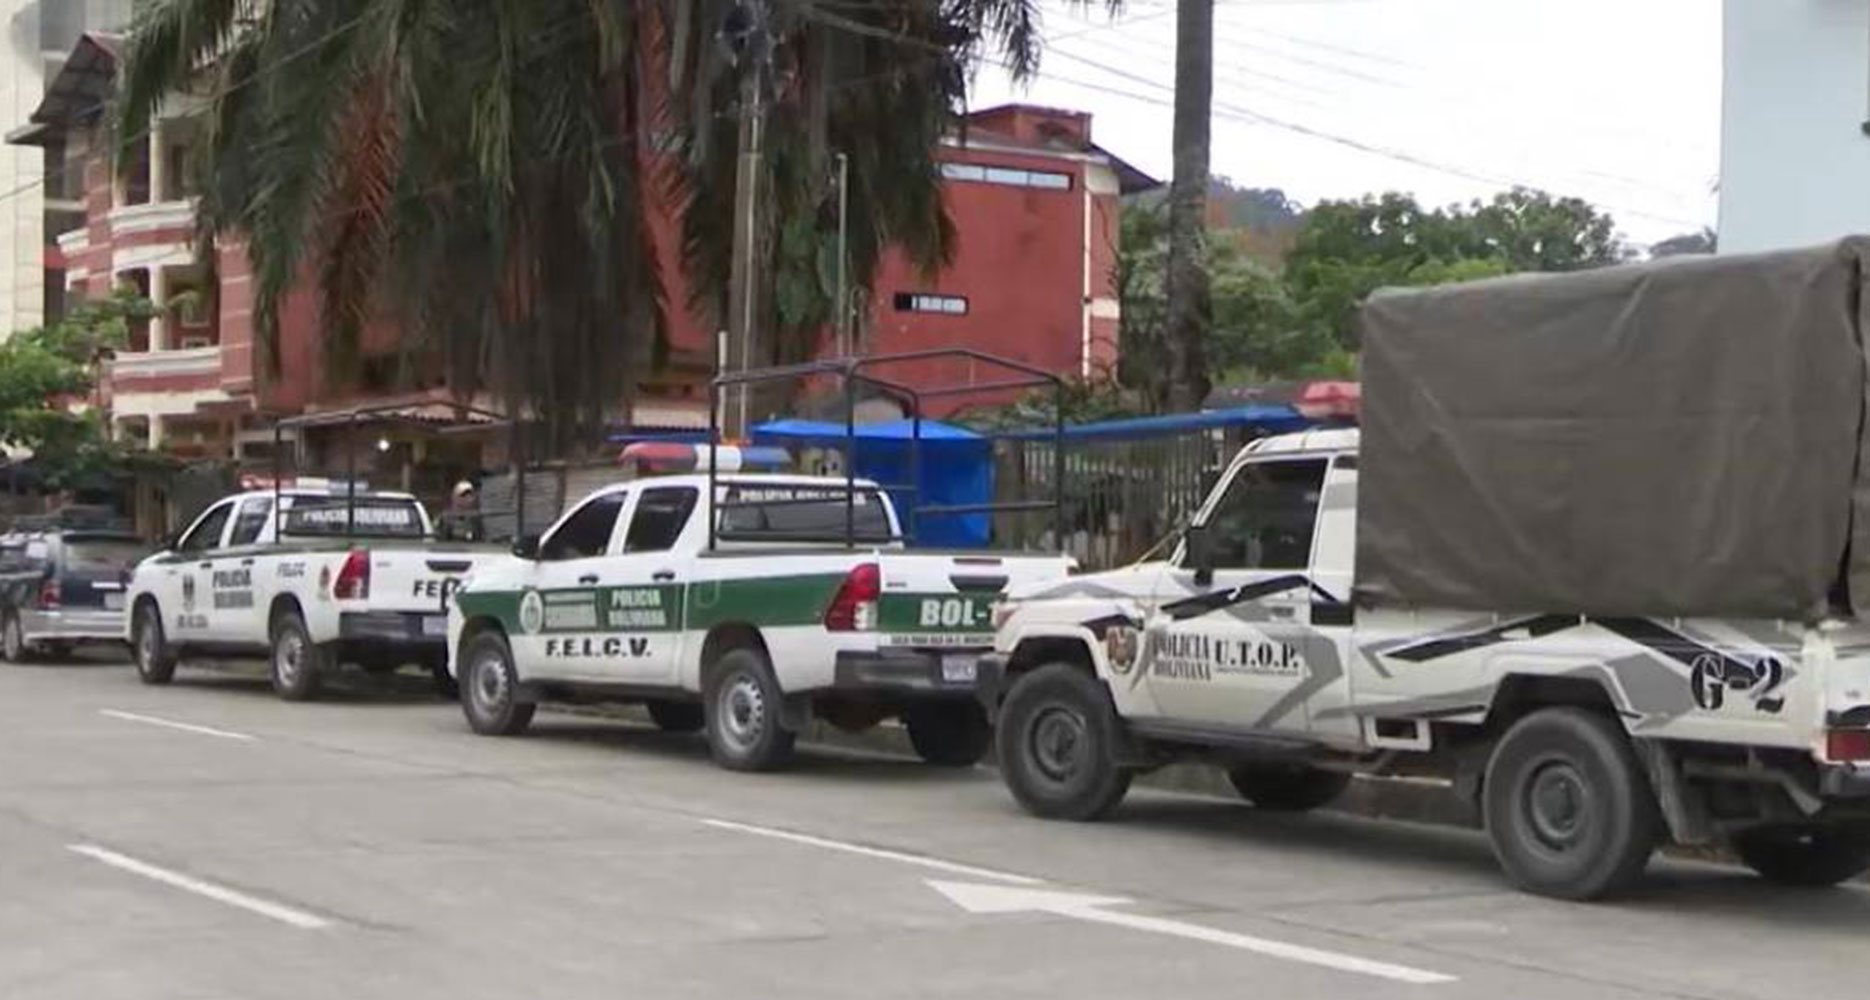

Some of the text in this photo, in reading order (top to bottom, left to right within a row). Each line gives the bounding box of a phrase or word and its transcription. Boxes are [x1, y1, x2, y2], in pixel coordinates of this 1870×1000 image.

[213, 570, 252, 588] POLICIA
[611, 589, 661, 607] POLICIA
[545, 637, 653, 657] F.E.L.C.V.
[1152, 633, 1210, 659] POLICIA
[1215, 639, 1299, 668] U.T.O.P.
[1691, 652, 1785, 713] G-2
